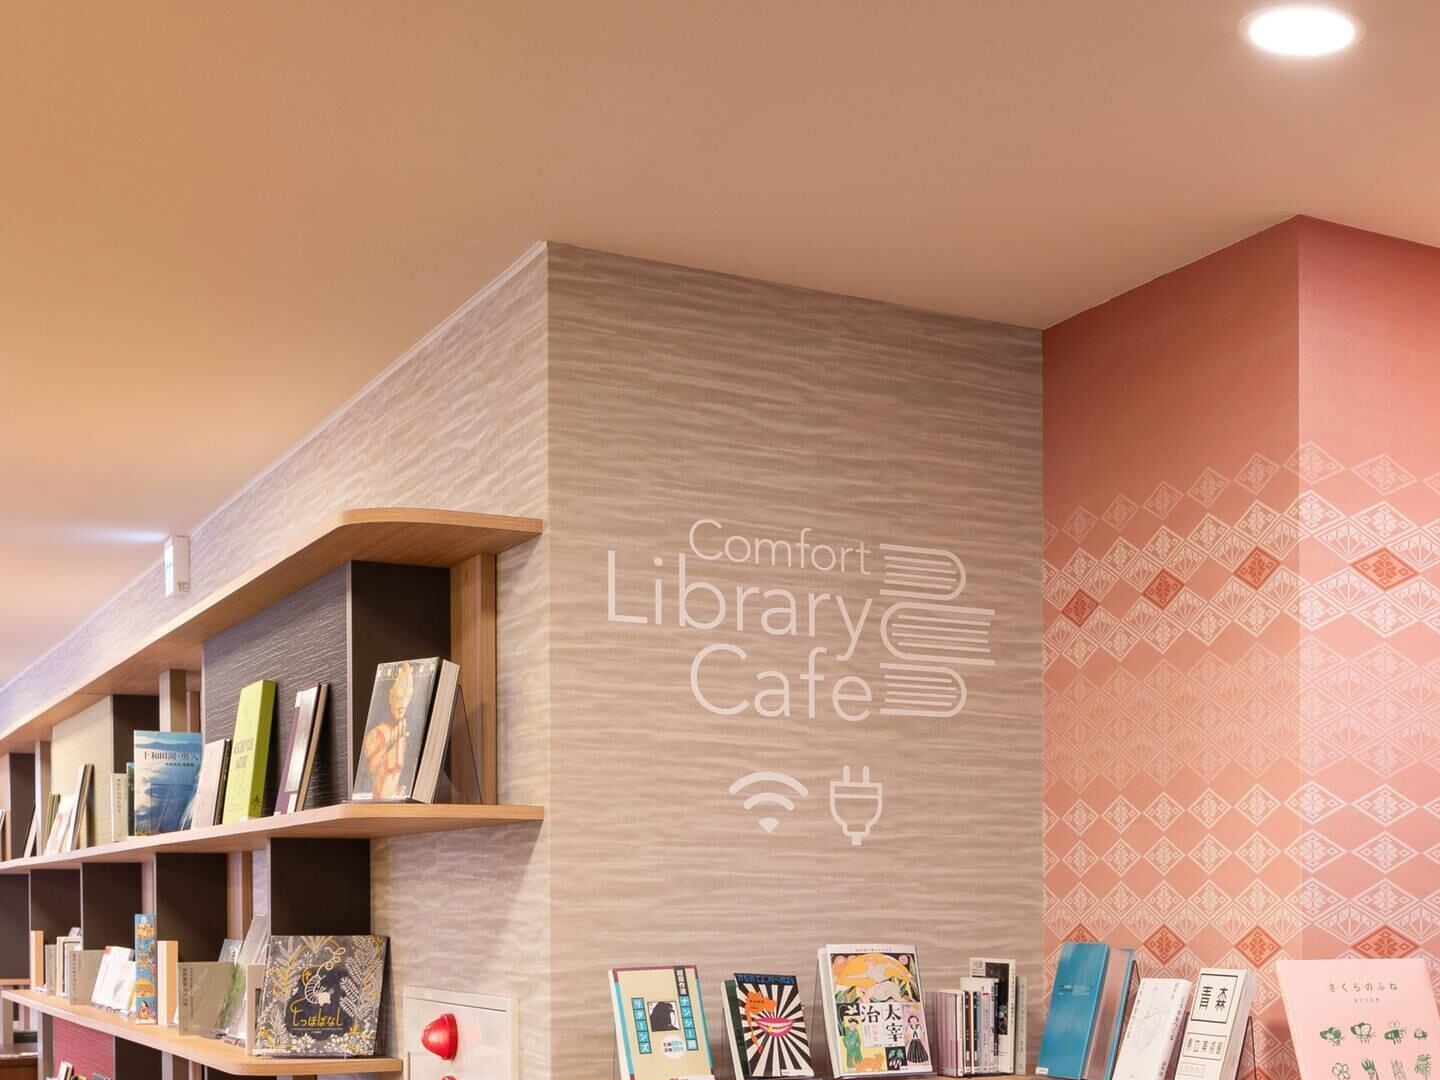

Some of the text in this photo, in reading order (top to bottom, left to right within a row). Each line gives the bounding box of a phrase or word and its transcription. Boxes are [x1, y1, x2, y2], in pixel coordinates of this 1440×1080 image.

[689, 519, 871, 575] Comfort
[607, 550, 873, 661] Library
[690, 643, 873, 721] Cafe
[884, 1004, 903, 1042] 太宰
